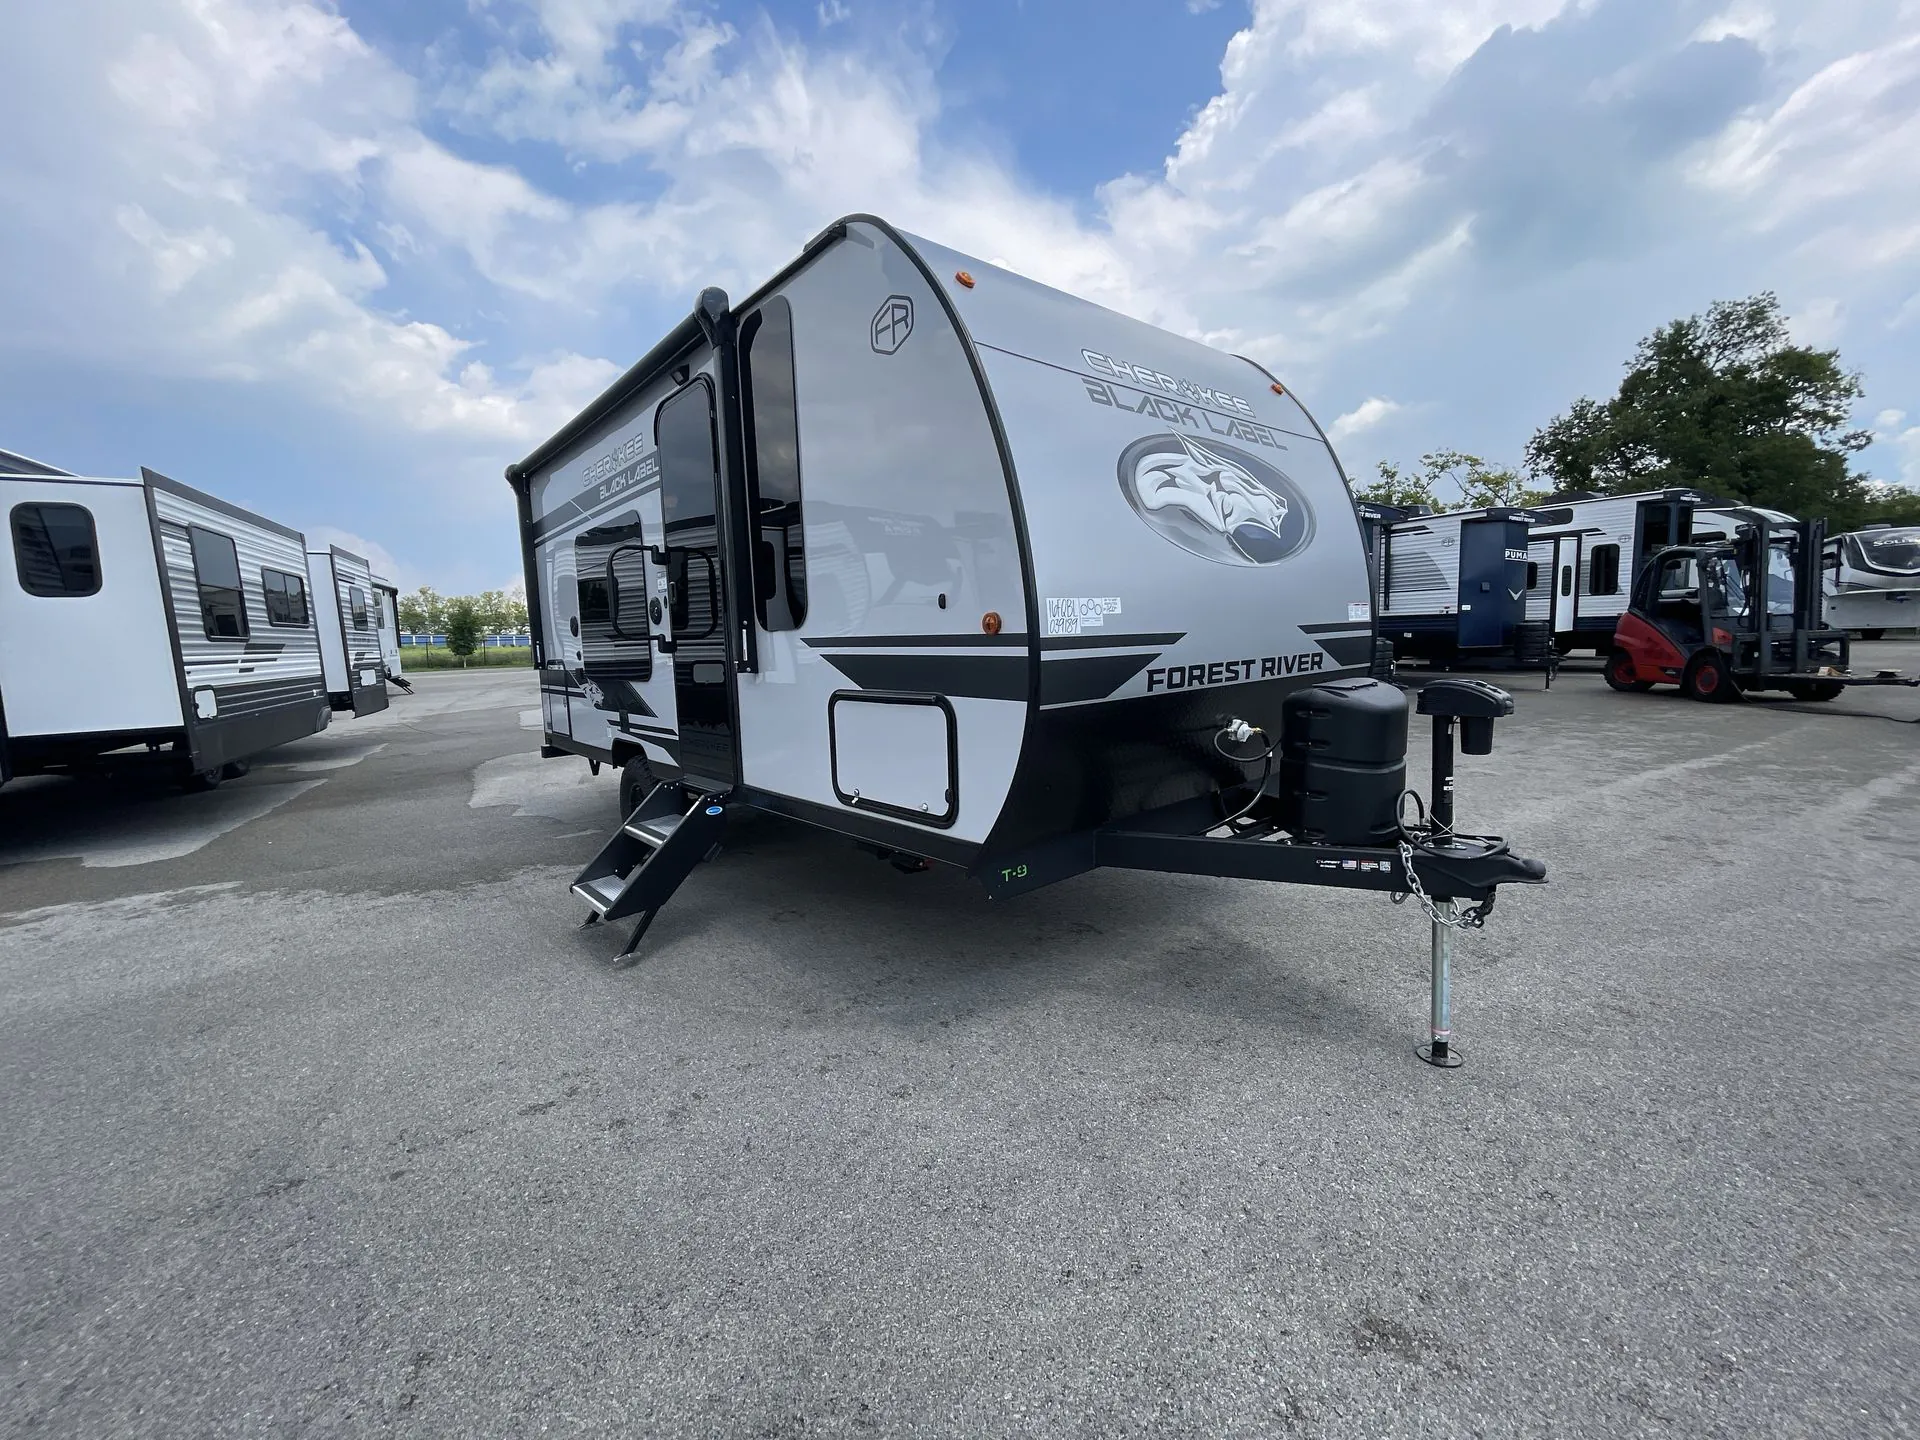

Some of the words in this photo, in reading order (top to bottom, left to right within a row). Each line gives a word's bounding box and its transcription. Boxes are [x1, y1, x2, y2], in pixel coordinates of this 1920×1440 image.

[1081, 348, 1257, 418] CHEROKEE
[1081, 377, 1200, 429] BLACK
[1202, 411, 1289, 451] LABEL
[582, 432, 644, 487] CHEROKEE
[599, 473, 627, 500] BLACK
[627, 457, 660, 485] LABEL
[1504, 550, 1528, 560] PUMA
[1146, 659, 1257, 692] FOREST
[1261, 652, 1324, 678] RIVER
